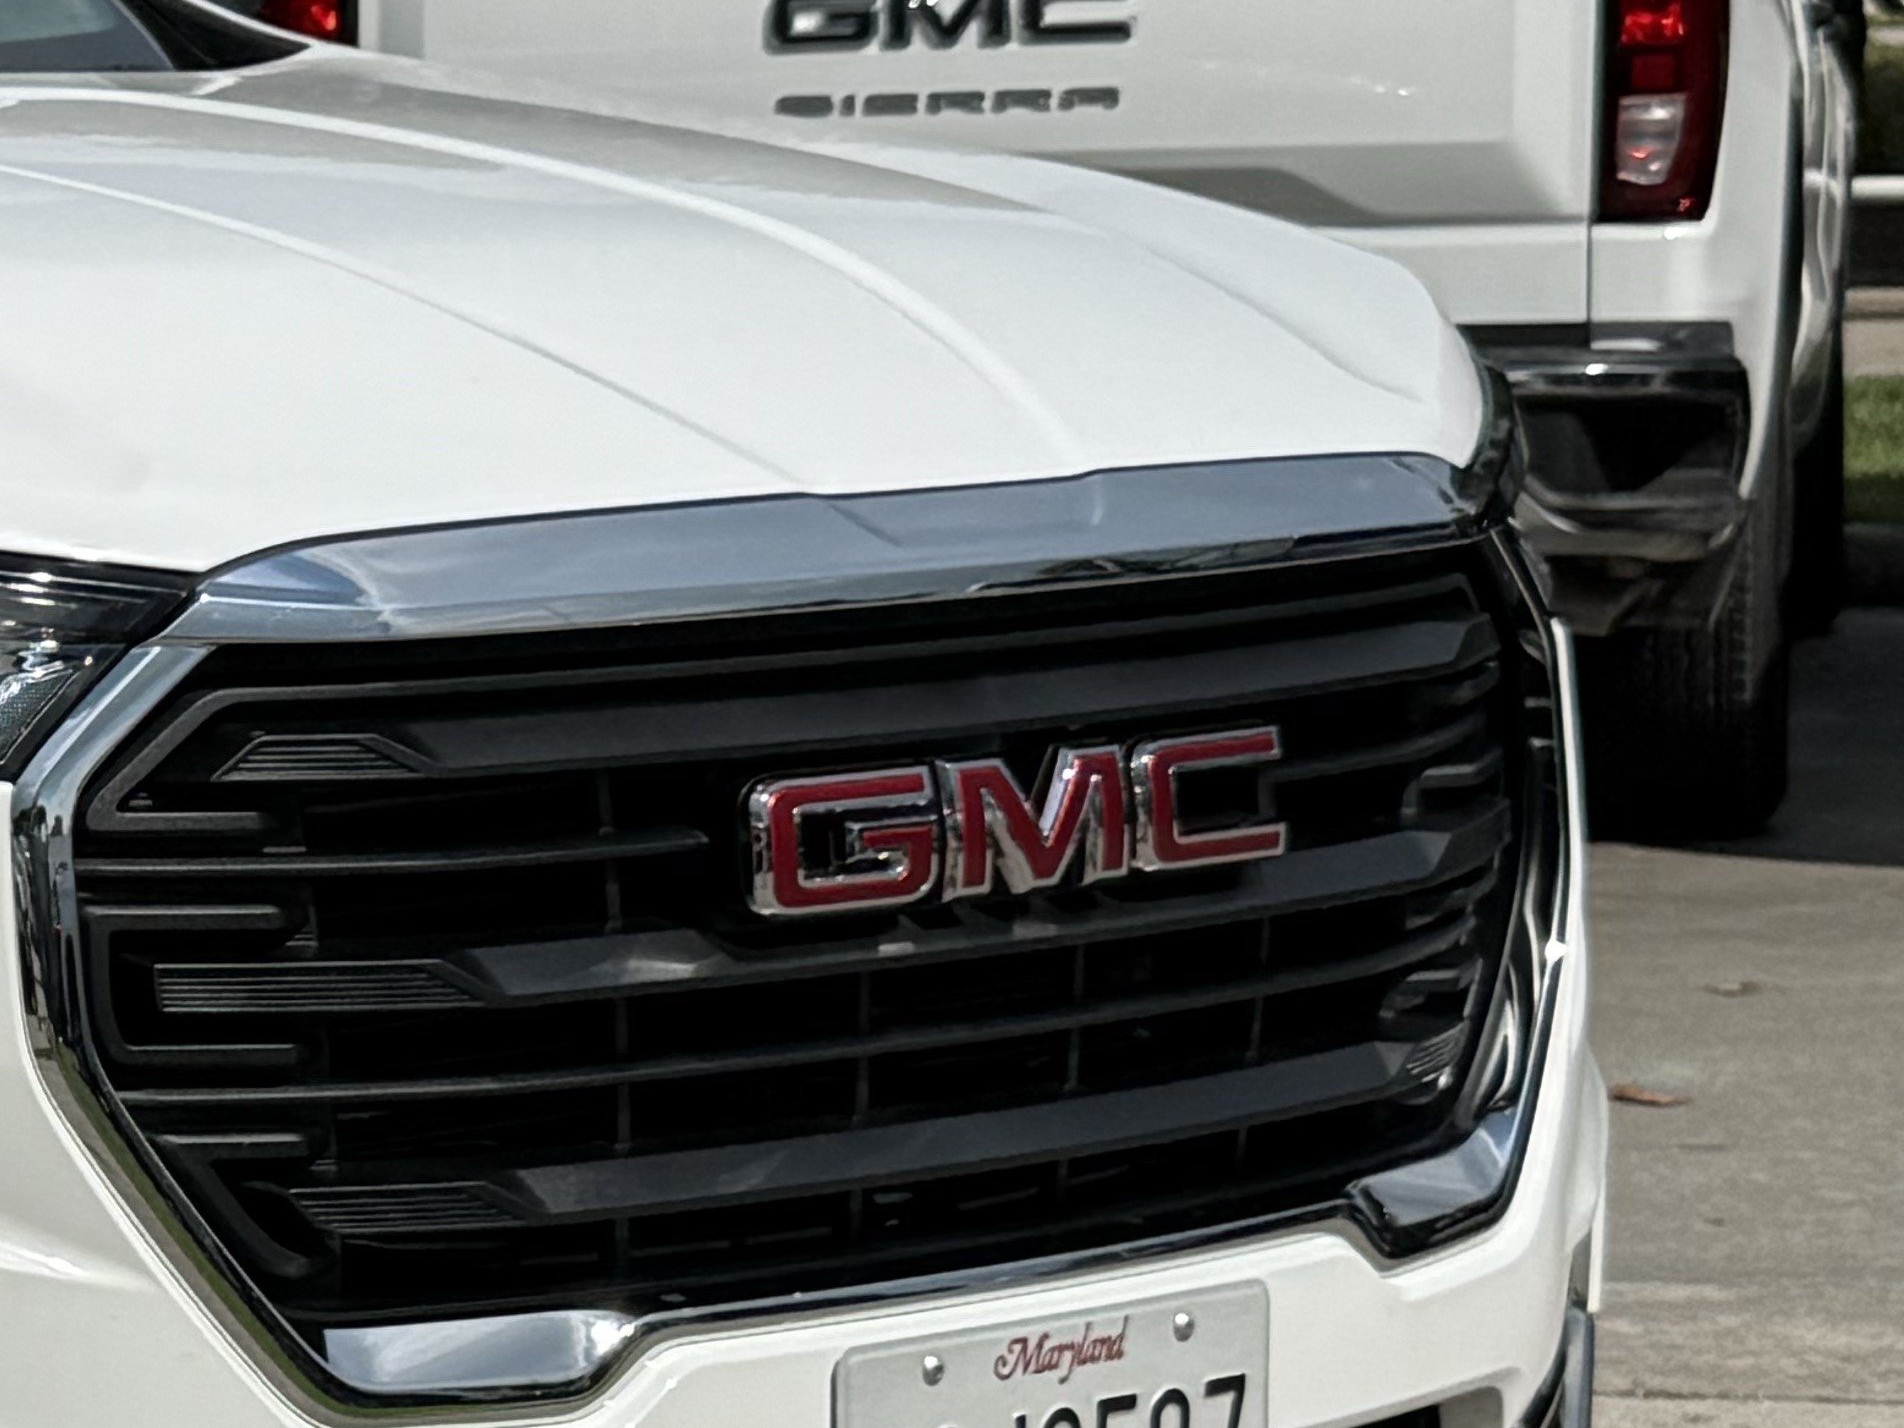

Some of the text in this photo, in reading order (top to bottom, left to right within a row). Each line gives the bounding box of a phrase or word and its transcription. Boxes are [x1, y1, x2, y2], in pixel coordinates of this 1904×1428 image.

[774, 86, 1120, 116] SIERRA
[747, 725, 1286, 918] GMC
[994, 1315, 1130, 1384] Maryland
